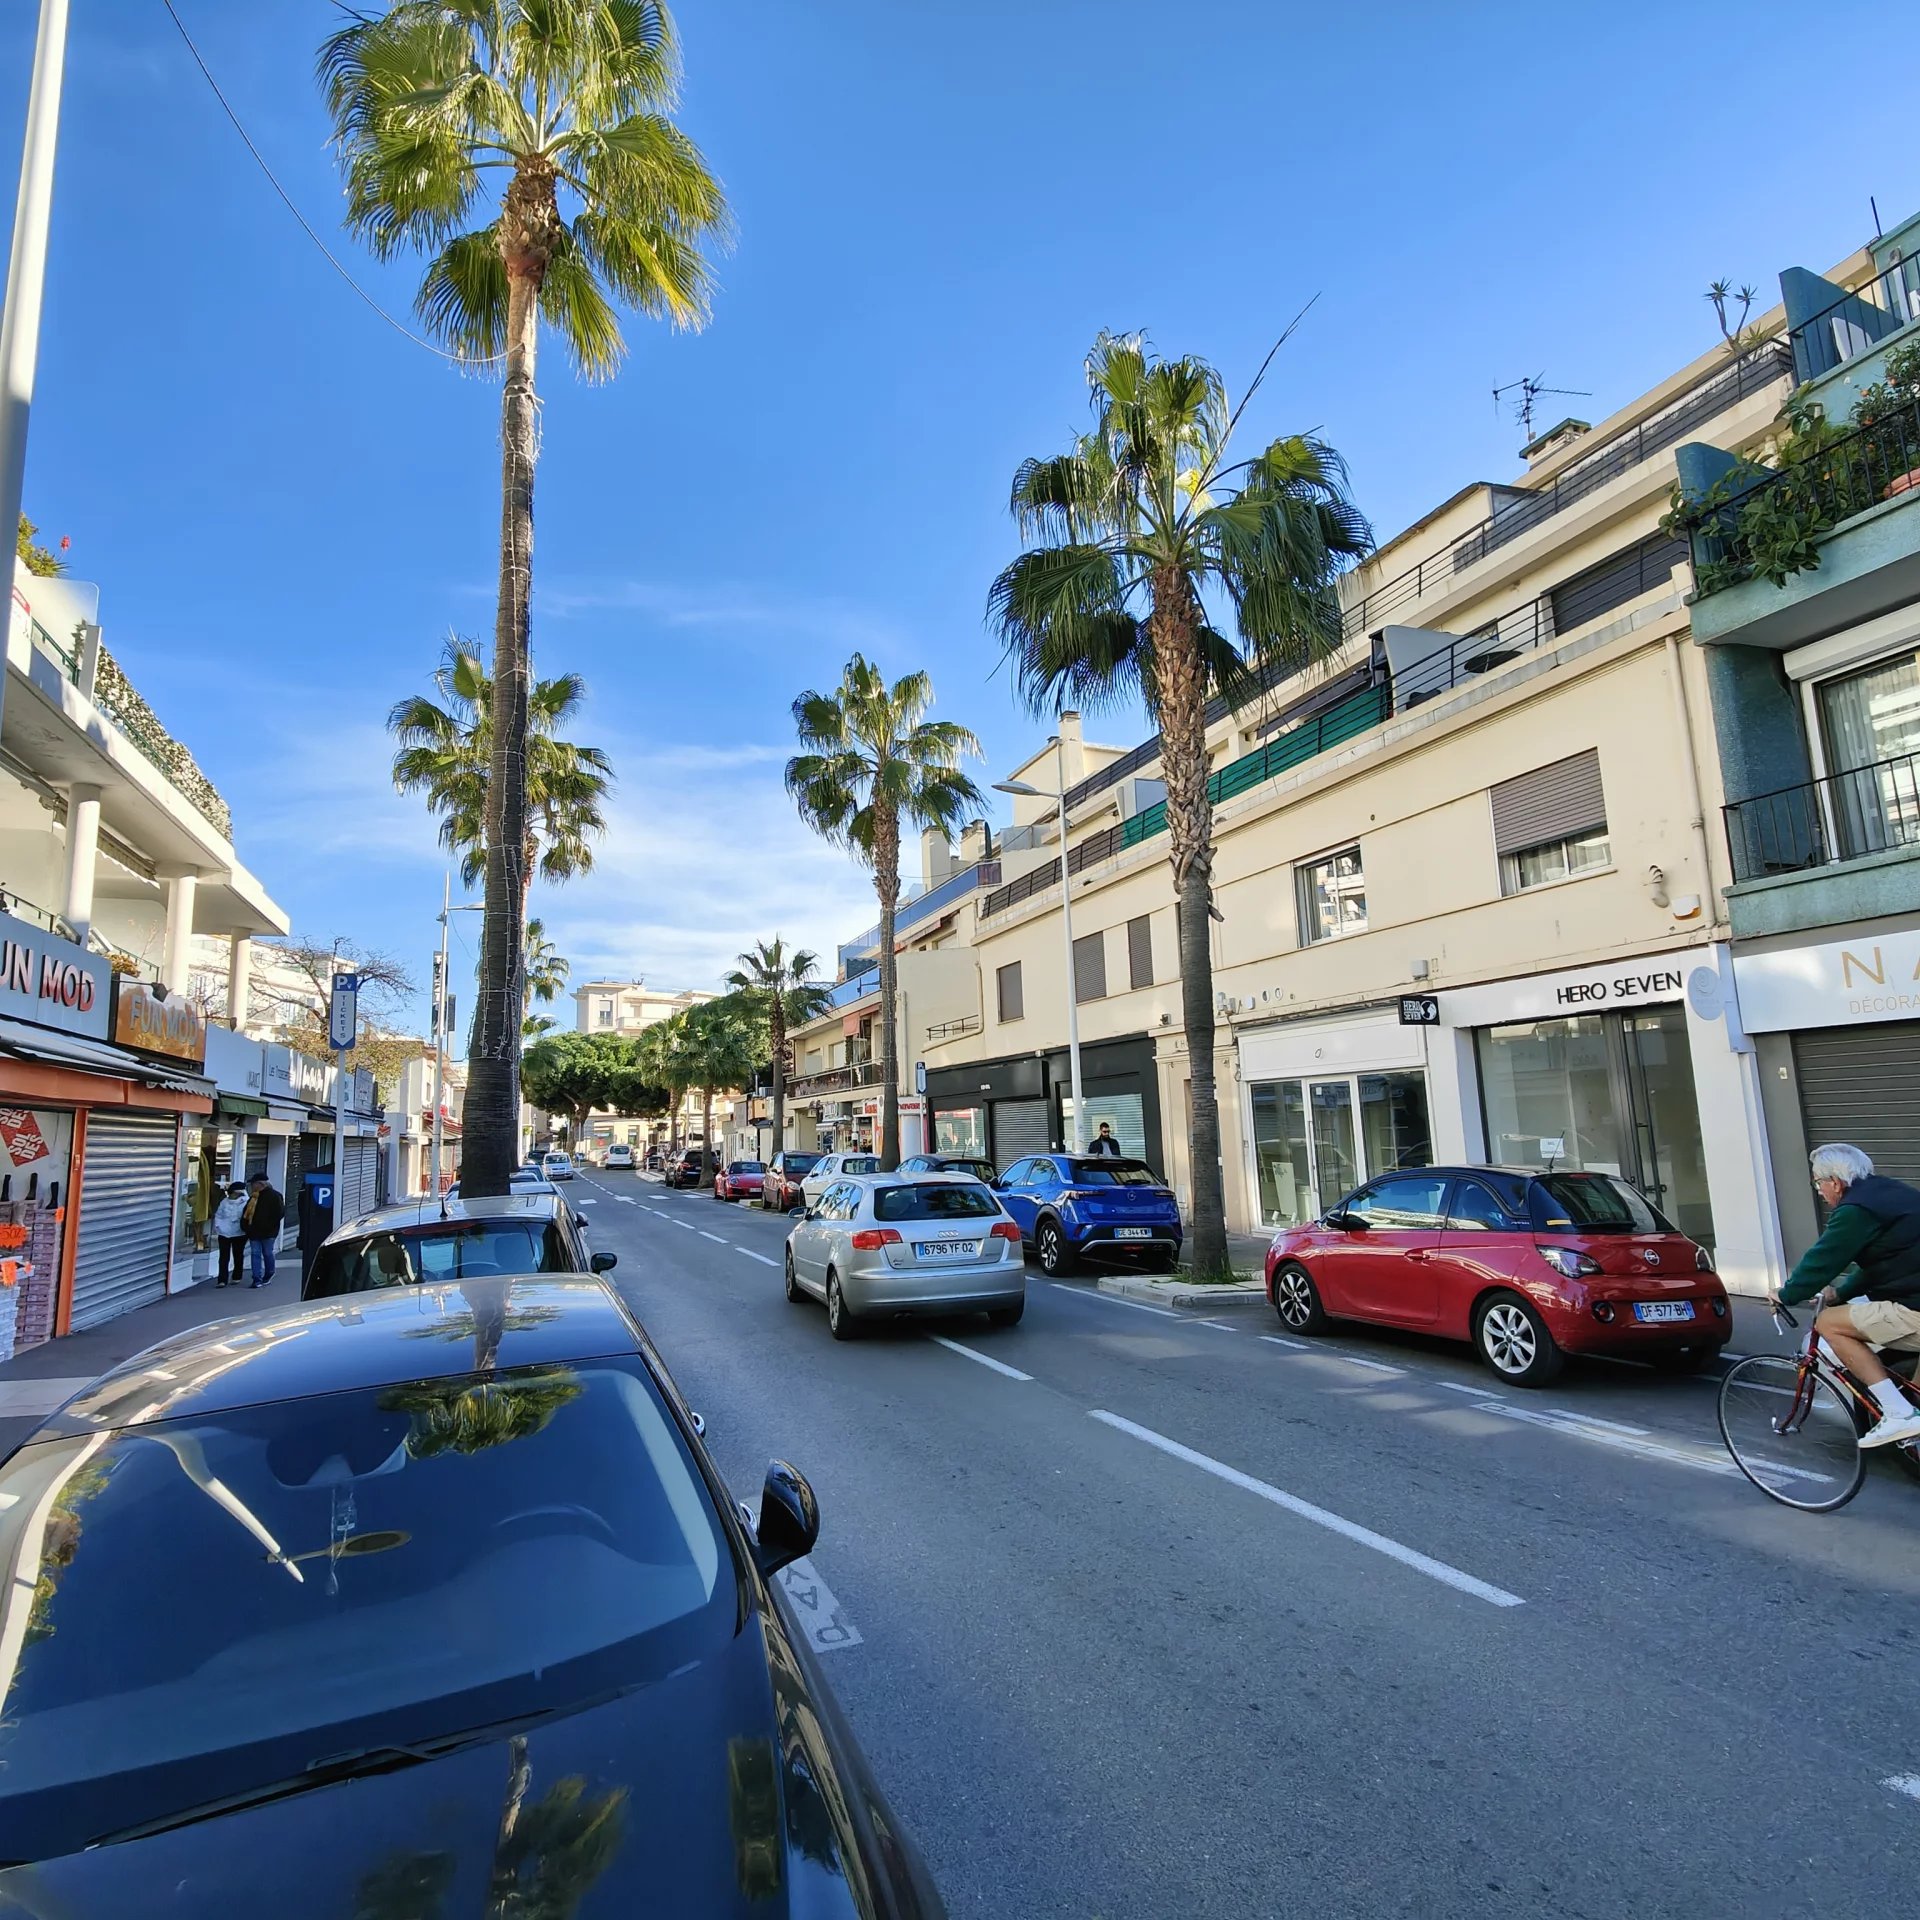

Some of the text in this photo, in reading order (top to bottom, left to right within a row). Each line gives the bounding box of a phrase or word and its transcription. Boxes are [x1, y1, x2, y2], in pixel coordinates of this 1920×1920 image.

[39, 954, 96, 1012] MOD
[1557, 970, 1683, 1005] HERO SEVEN
[1403, 1000, 1421, 1011] HERO
[130, 994, 199, 1047] FUN MOD
[1404, 1011, 1422, 1021] SEVEN
[8, 1133, 32, 1156] SOL
[20, 1134, 44, 1160] DES
[318, 1187, 331, 1205] P
[924, 1242, 974, 1256] 6796 YF 02
[1641, 1303, 1688, 1318] DF-577-BH
